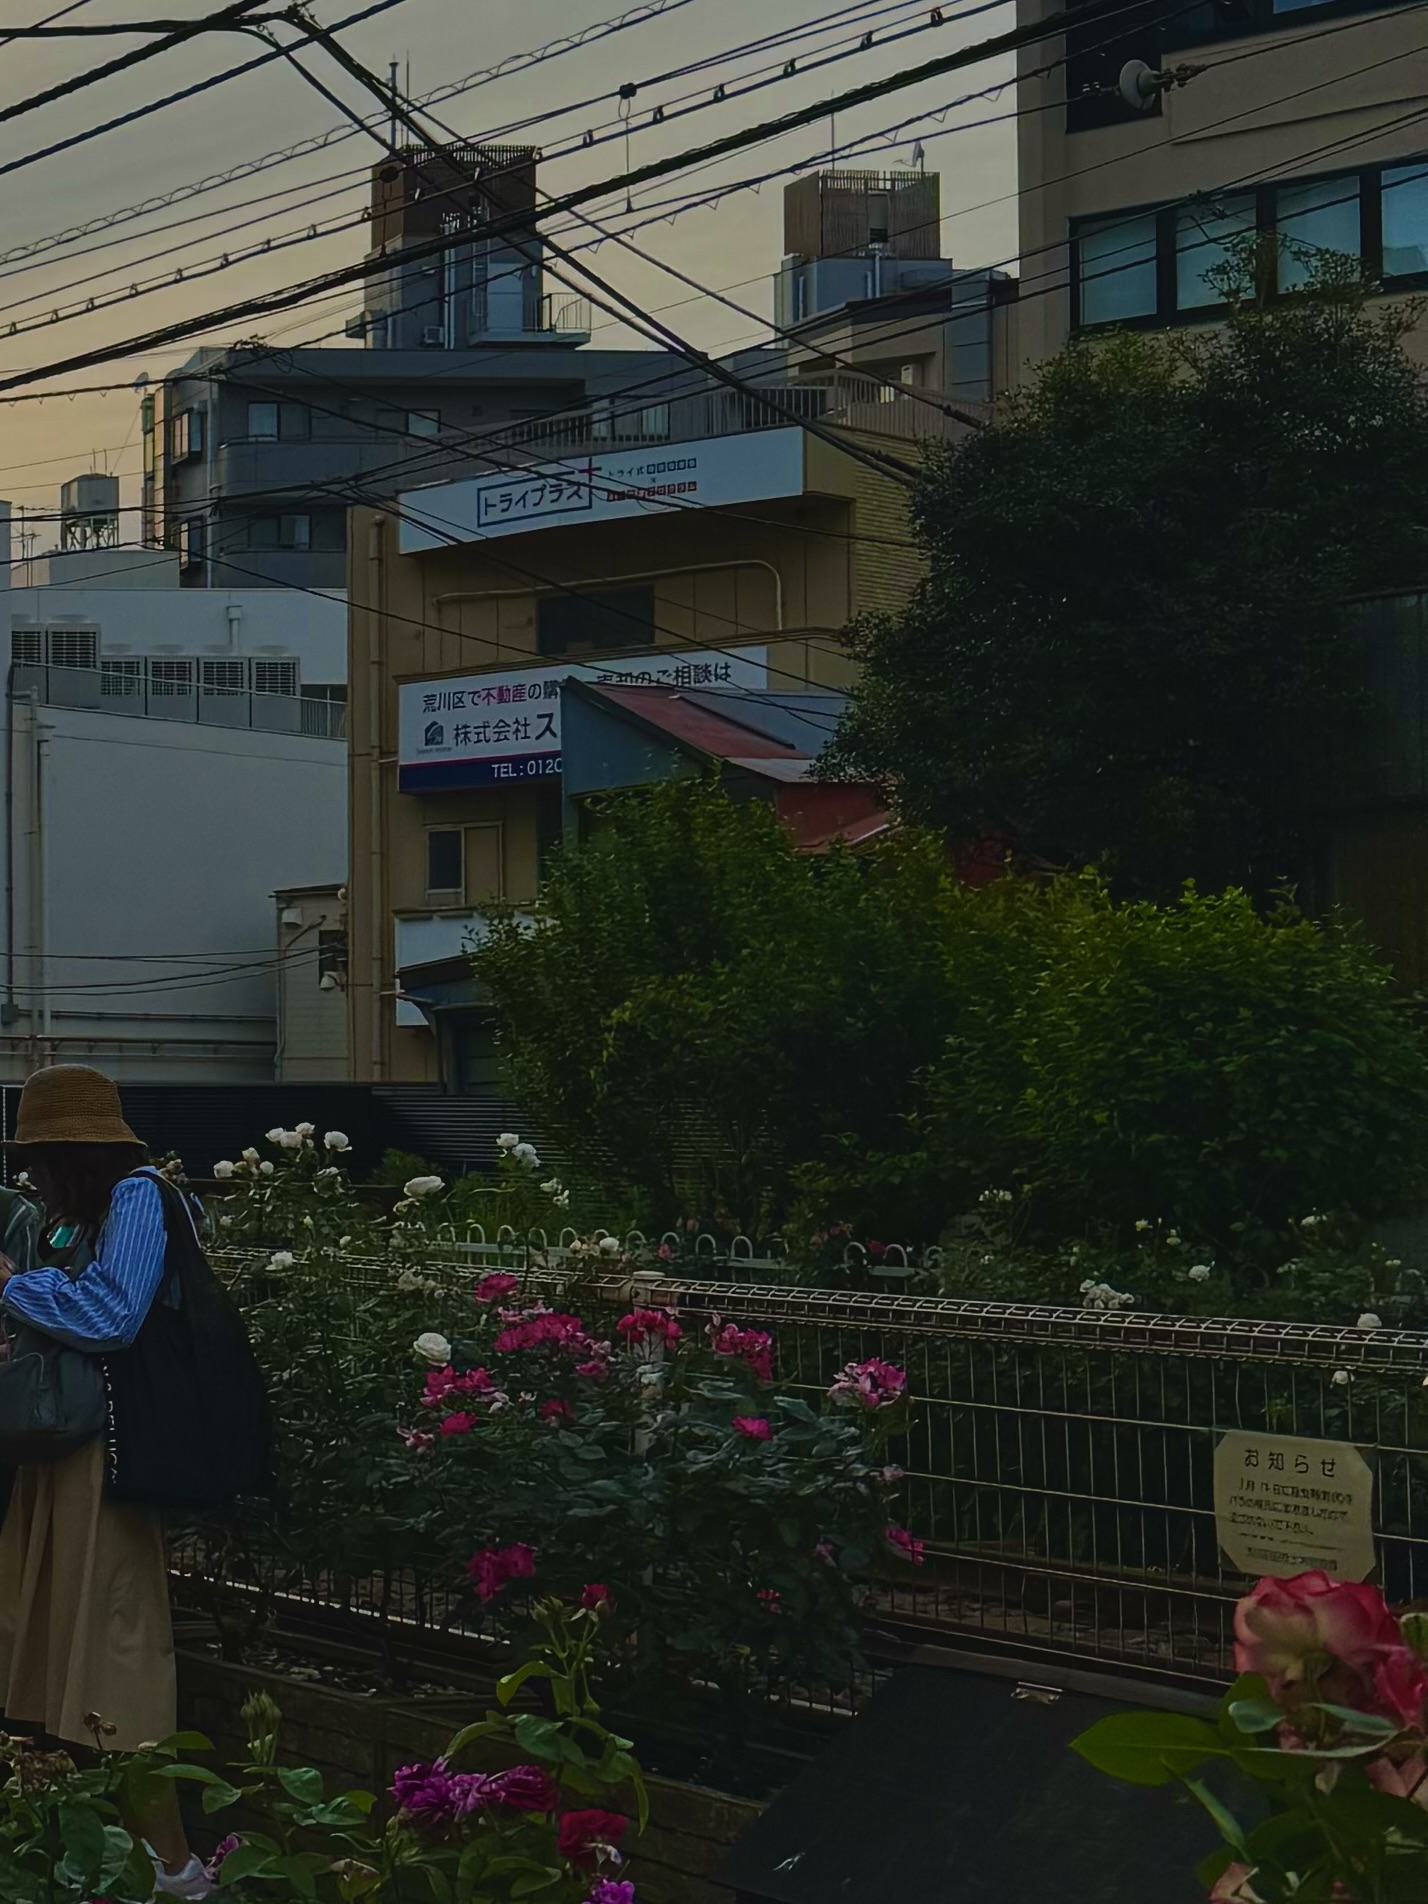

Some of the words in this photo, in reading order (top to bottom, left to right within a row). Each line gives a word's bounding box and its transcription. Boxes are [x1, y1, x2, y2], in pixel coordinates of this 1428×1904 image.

[483, 482, 583, 517] トライプラス
[1244, 1448, 1336, 1478] お知らせ
